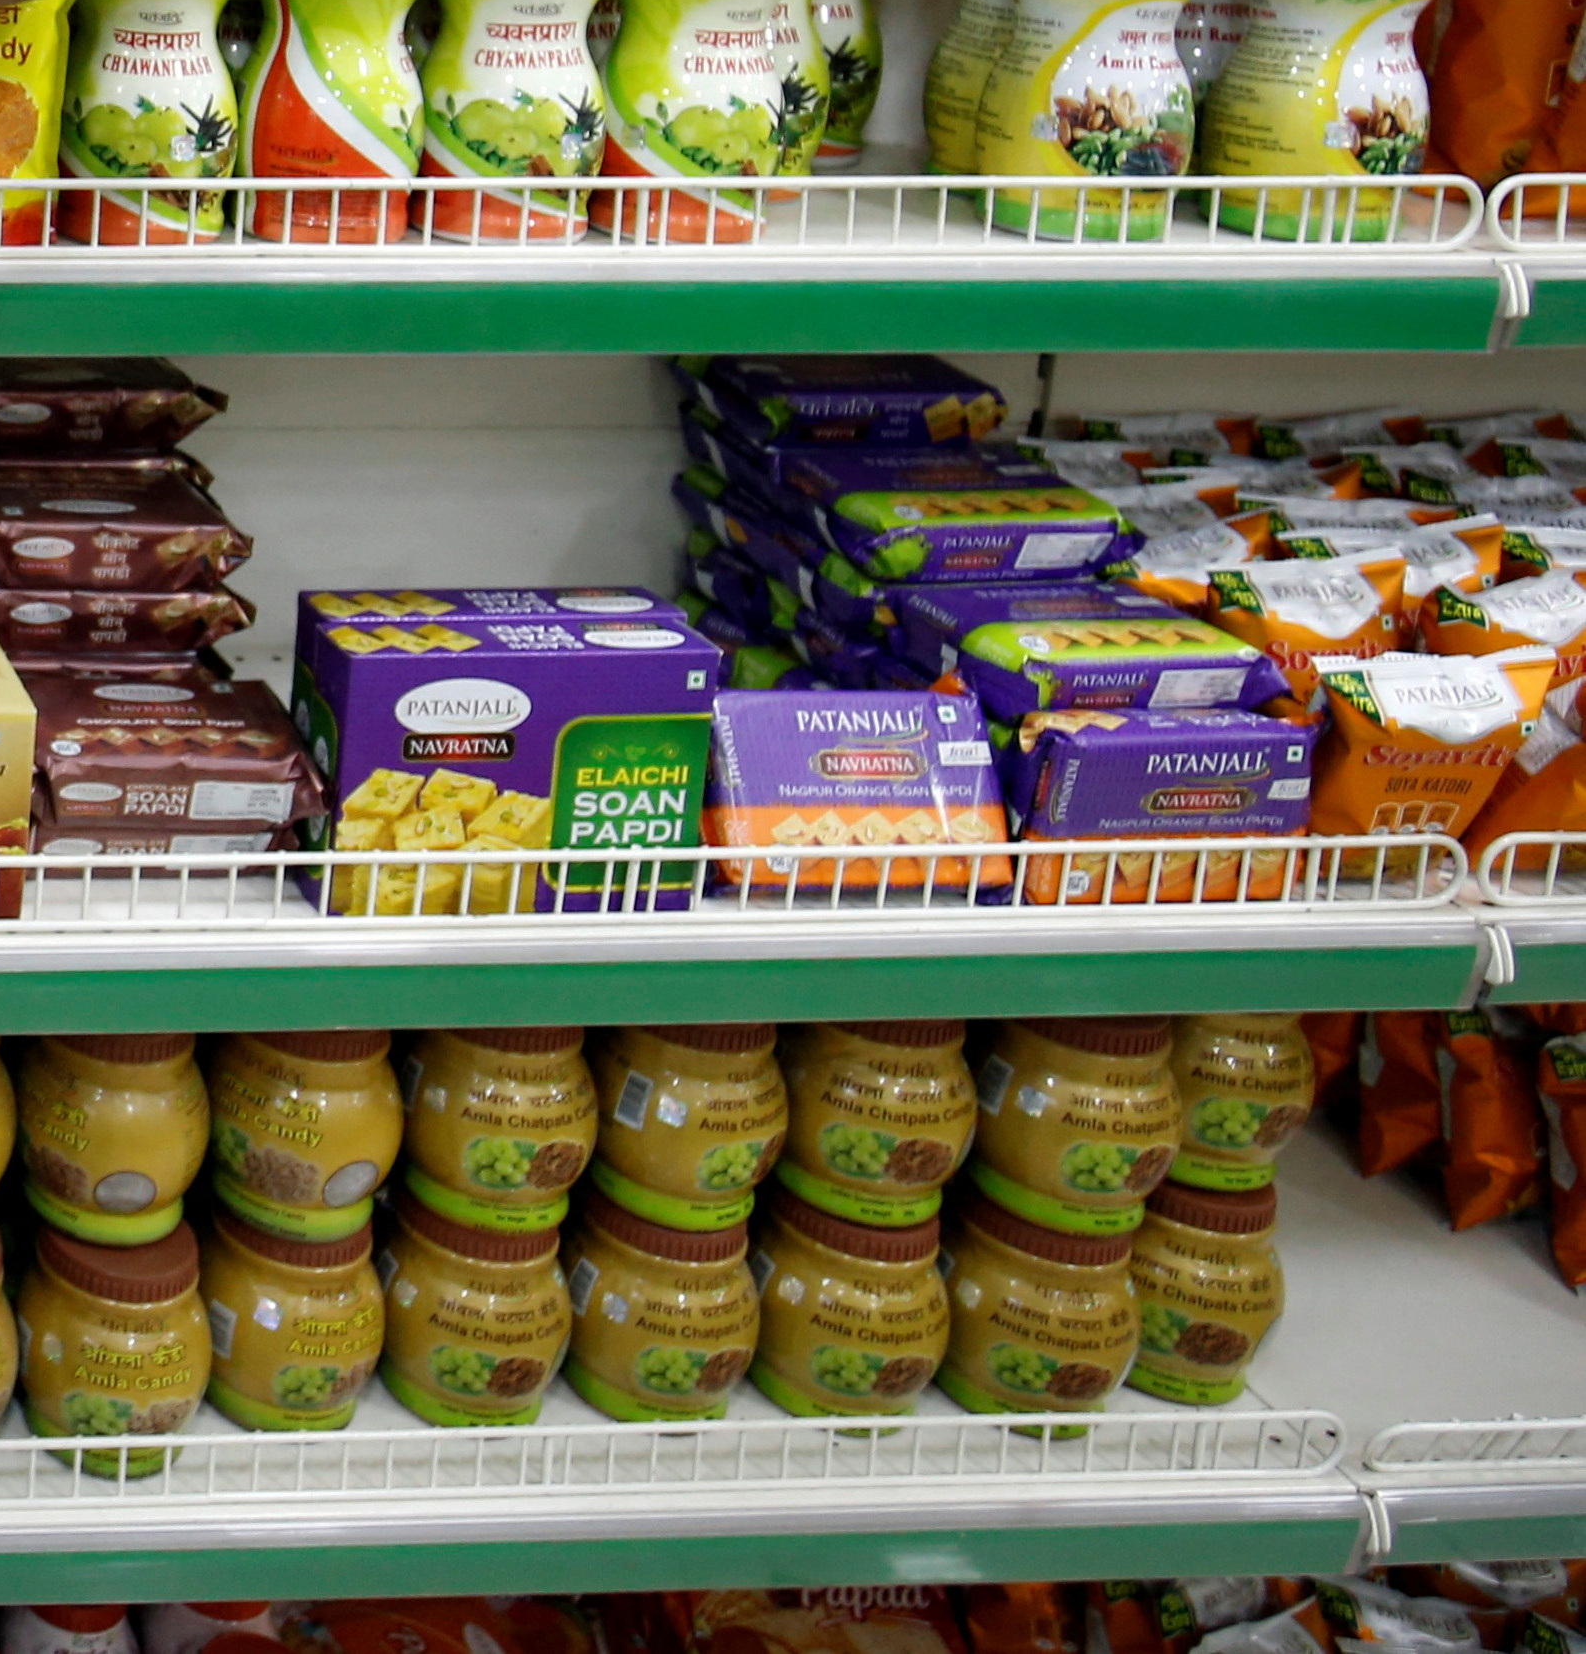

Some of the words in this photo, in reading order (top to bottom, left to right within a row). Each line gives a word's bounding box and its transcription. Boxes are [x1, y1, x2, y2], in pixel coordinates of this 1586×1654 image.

[113, 28, 201, 50] च्यवनप्राश
[486, 21, 577, 43] च्यवनप्राश
[943, 535, 1012, 549] PATANJALI
[1072, 673, 1146, 688] PATANJALI
[1397, 682, 1494, 706] PATANJALI
[407, 697, 517, 720] PATANJALI
[796, 709, 922, 733] PATANJALI
[410, 737, 508, 756] NAVRATNA
[827, 755, 914, 774] NAVRATNA
[1147, 751, 1265, 776] PATANJALI
[577, 766, 689, 787] ELAICHI
[1385, 776, 1418, 793] SOYA
[1421, 776, 1473, 794] KATORI
[127, 792, 188, 806] SOAN
[780, 784, 831, 797] NAGPUR
[834, 784, 889, 797] ORANGE
[1157, 792, 1240, 810] NAVRATNA
[124, 803, 186, 817] PAPDI
[573, 789, 687, 817] SOAN
[570, 818, 682, 846] PAPDI
[130, 1367, 191, 1392] Candy
